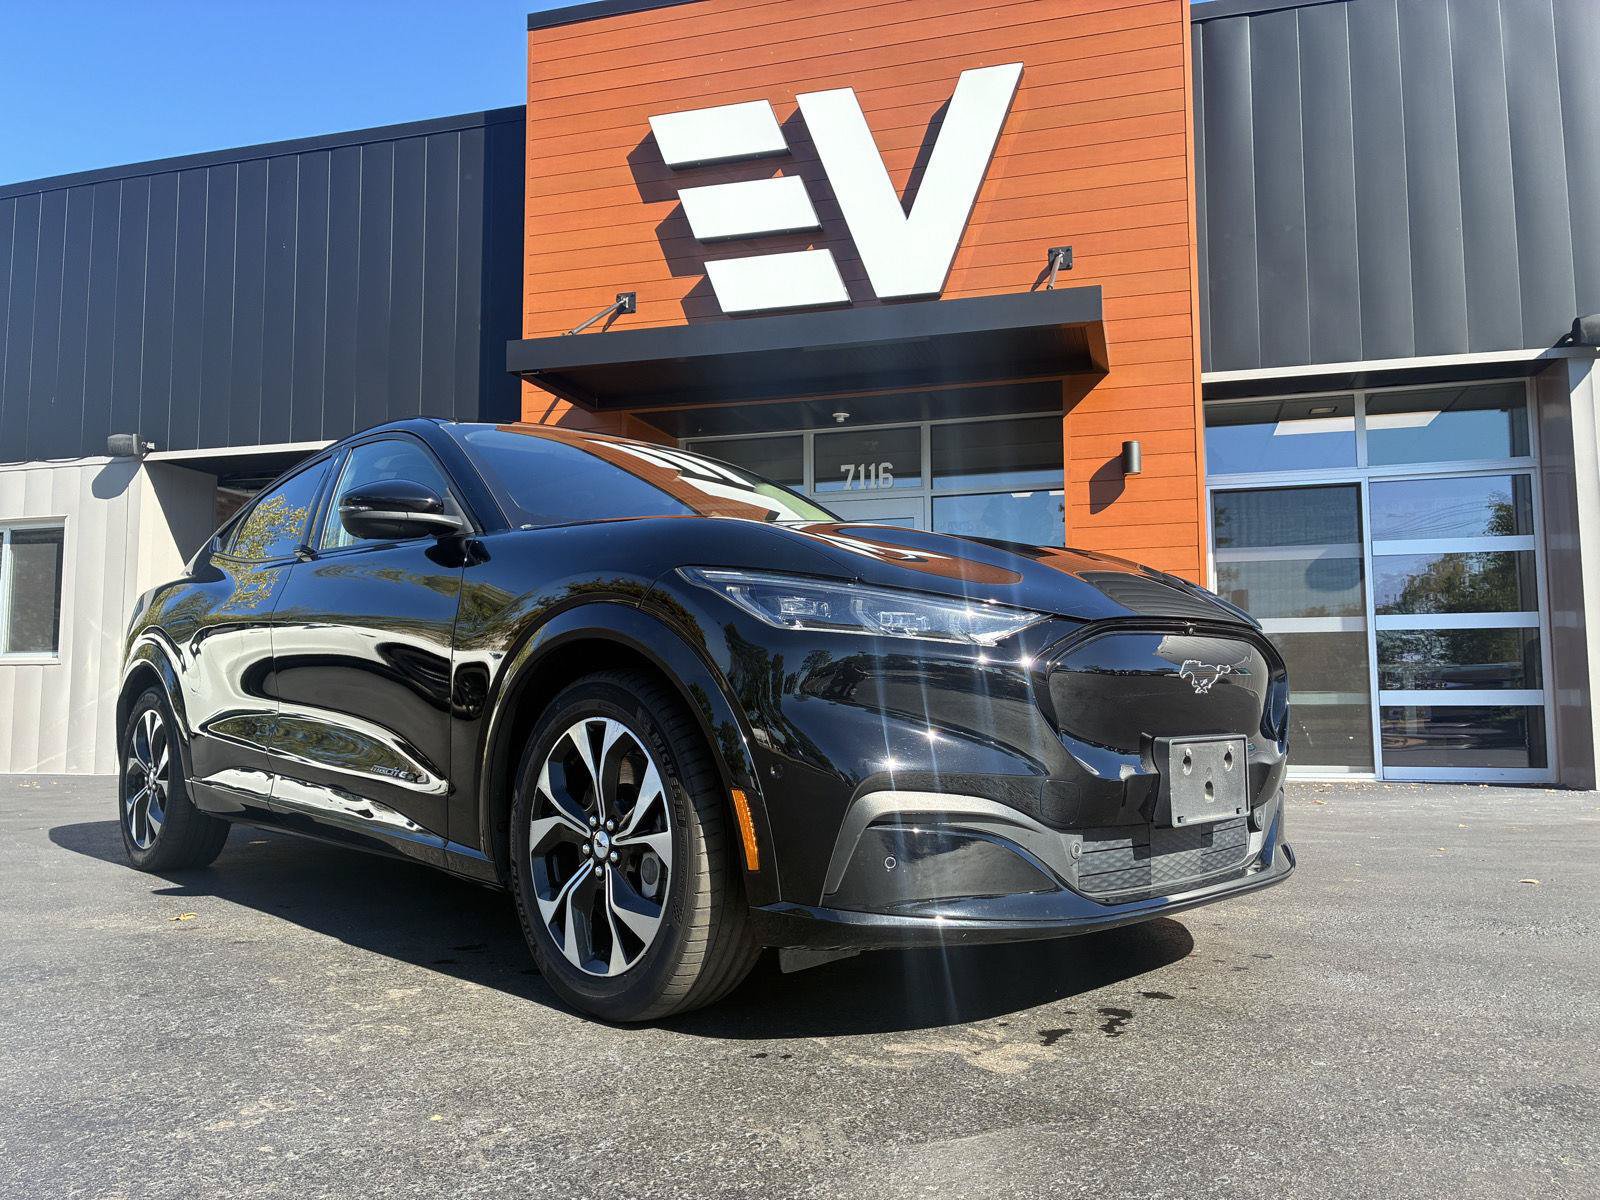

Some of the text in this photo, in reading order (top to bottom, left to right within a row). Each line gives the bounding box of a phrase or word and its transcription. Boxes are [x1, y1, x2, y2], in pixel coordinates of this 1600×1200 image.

[648, 62, 1024, 314] EV
[840, 462, 894, 490] 7116
[651, 732, 686, 822] MICHELIN
